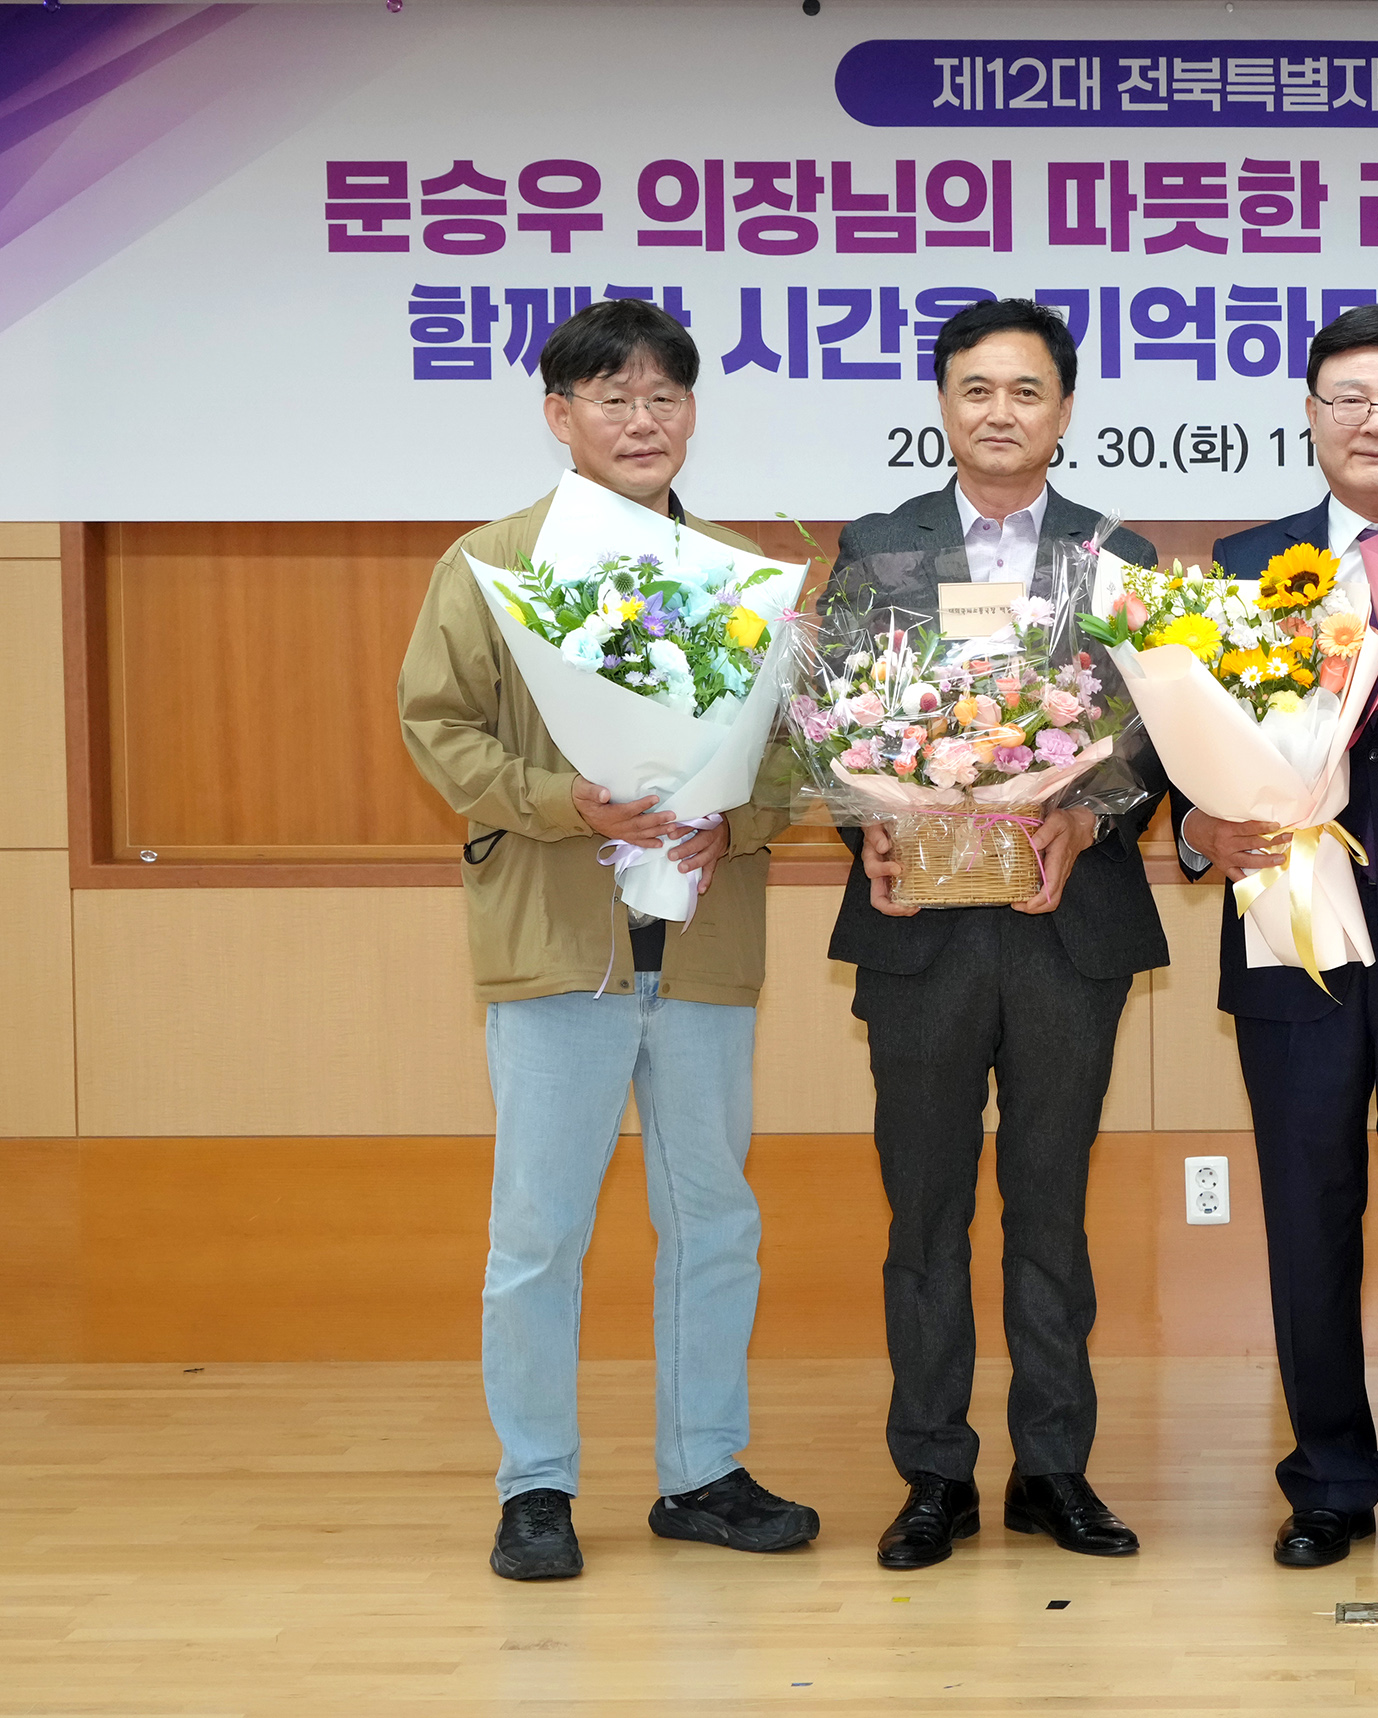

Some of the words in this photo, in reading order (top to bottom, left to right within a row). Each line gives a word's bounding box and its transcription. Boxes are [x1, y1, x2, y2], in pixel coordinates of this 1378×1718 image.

[933, 58, 1102, 113] 제12대
[325, 160, 605, 257] 문승우
[637, 160, 1014, 257] 의장님의
[1048, 158, 1330, 256] 따뜻한
[1097, 423, 1250, 475] 30.(화)
